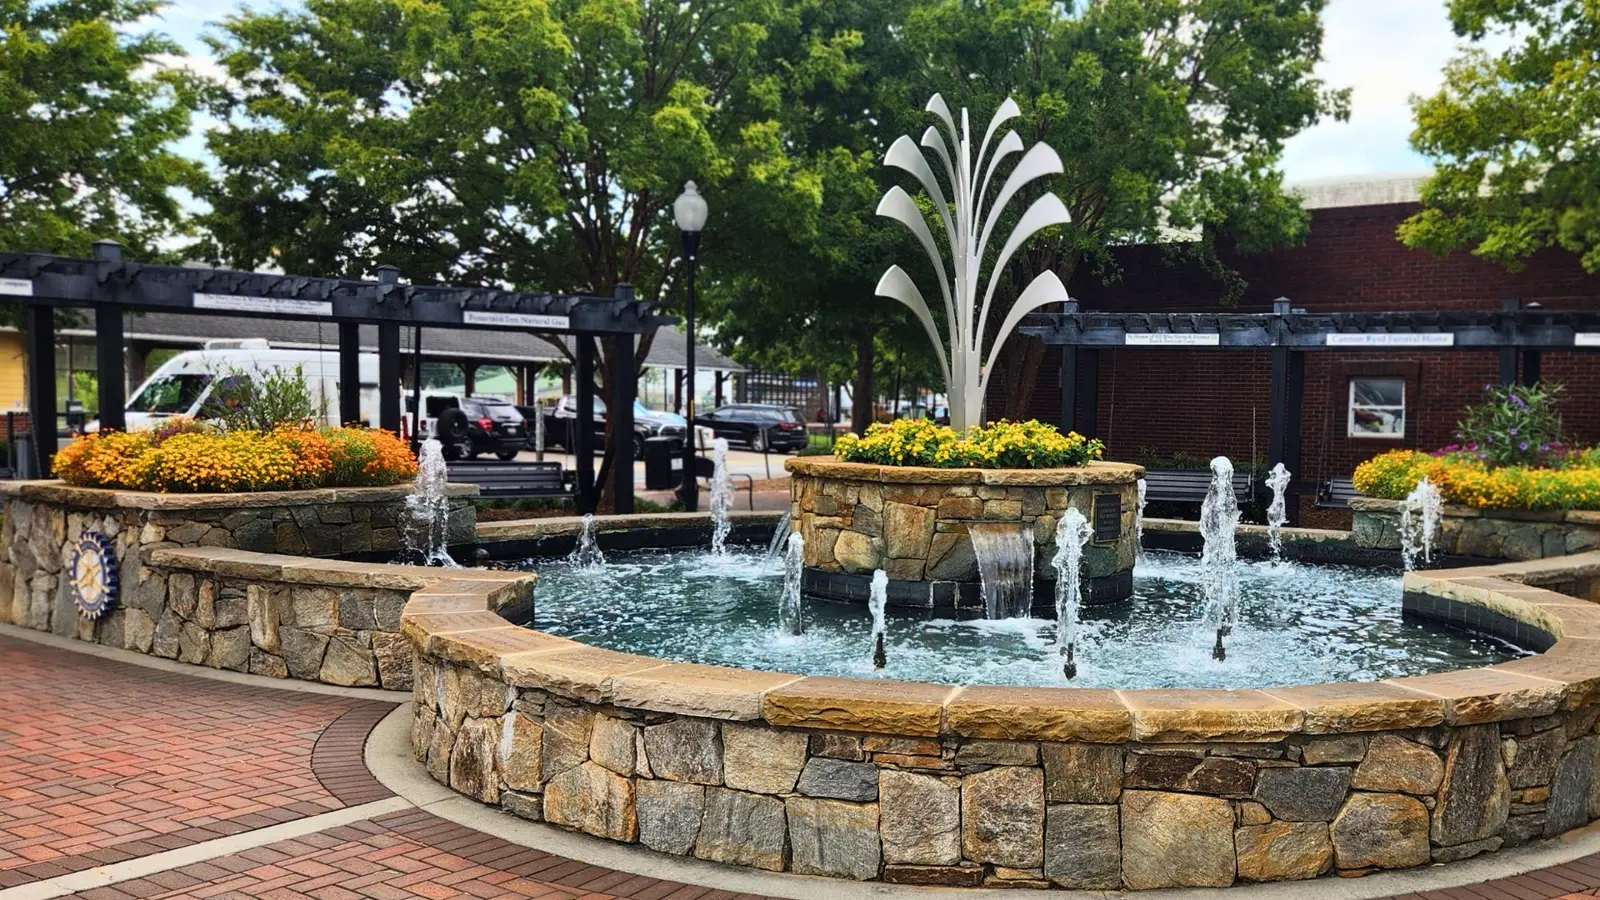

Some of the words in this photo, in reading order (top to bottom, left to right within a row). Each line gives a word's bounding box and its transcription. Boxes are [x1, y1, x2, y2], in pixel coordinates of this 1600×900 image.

[468, 313, 505, 323] Fountain
[521, 316, 550, 325] Natural
[551, 318, 566, 326] Gas
[1422, 335, 1449, 343] Home
